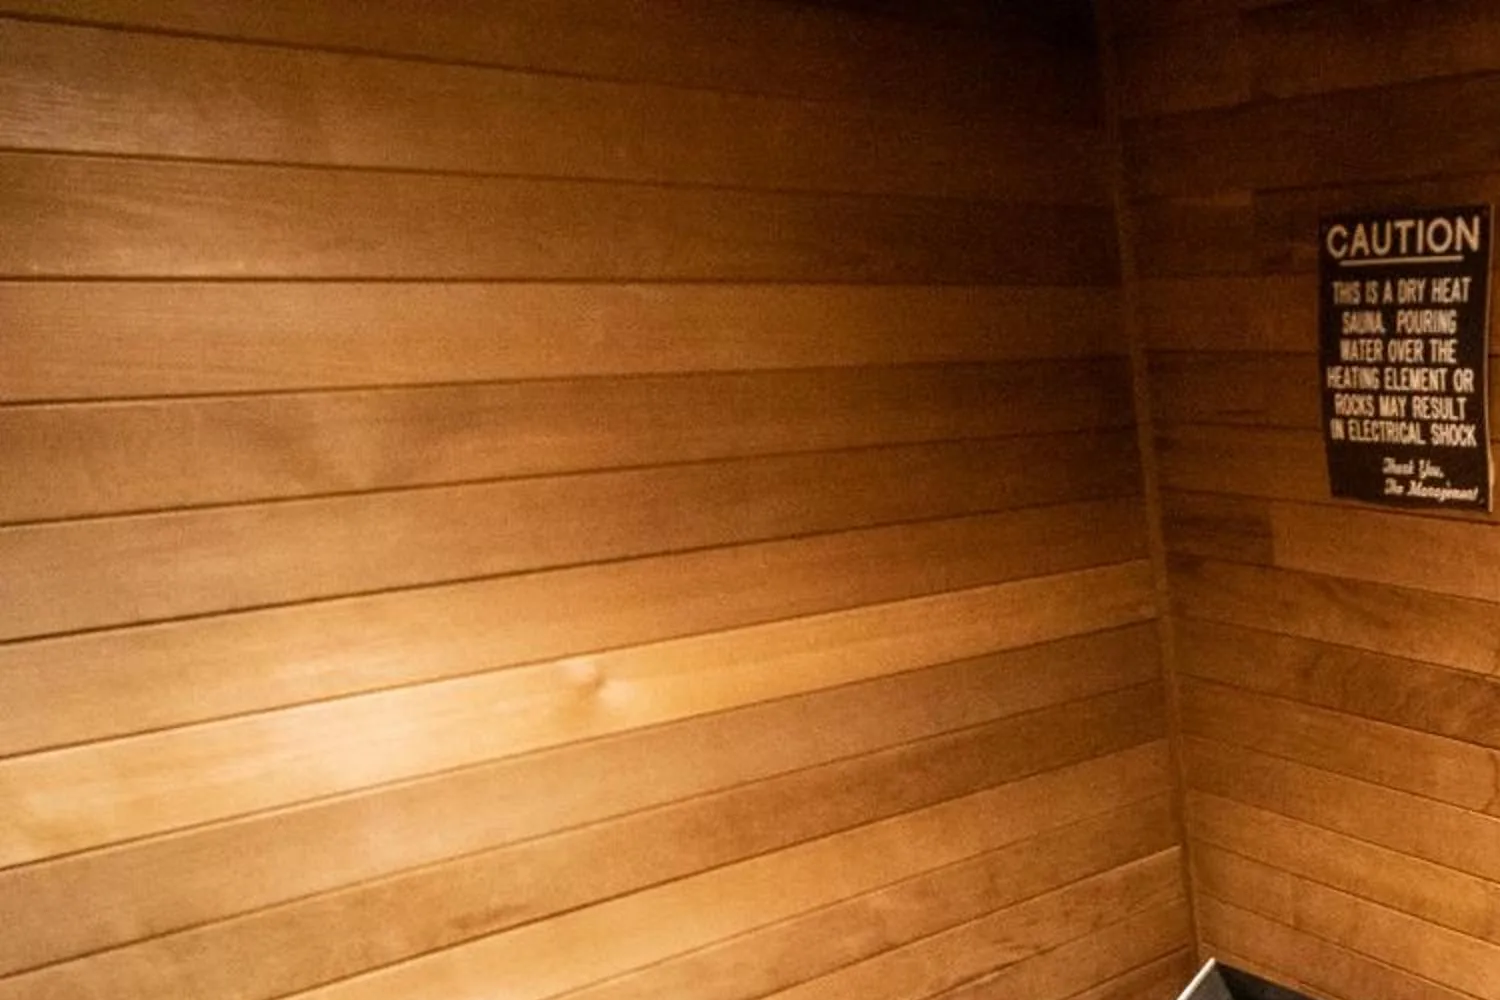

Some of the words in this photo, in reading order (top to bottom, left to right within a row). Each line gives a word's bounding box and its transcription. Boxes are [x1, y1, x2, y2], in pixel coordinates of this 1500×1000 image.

[1327, 216, 1480, 258] CAUTION
[1333, 280, 1361, 305] THIS
[1365, 280, 1379, 304] IS
[1383, 278, 1393, 304] A
[1397, 277, 1426, 304] DRY
[1430, 276, 1472, 303] HEAT
[1396, 309, 1457, 335] POURING
[1340, 338, 1383, 362] WATER
[1387, 338, 1424, 363] OVER
[1429, 338, 1458, 364] THE
[1327, 365, 1380, 389] HEATING
[1383, 367, 1449, 393] ELEMENT
[1453, 368, 1475, 393] OR
[1334, 393, 1375, 417] ROCKS
[1379, 395, 1407, 418] MAY
[1411, 396, 1467, 421] RESULT
[1330, 418, 1345, 441] IN
[1348, 418, 1426, 445] ELECTRICAL
[1430, 422, 1477, 447] SHOCK
